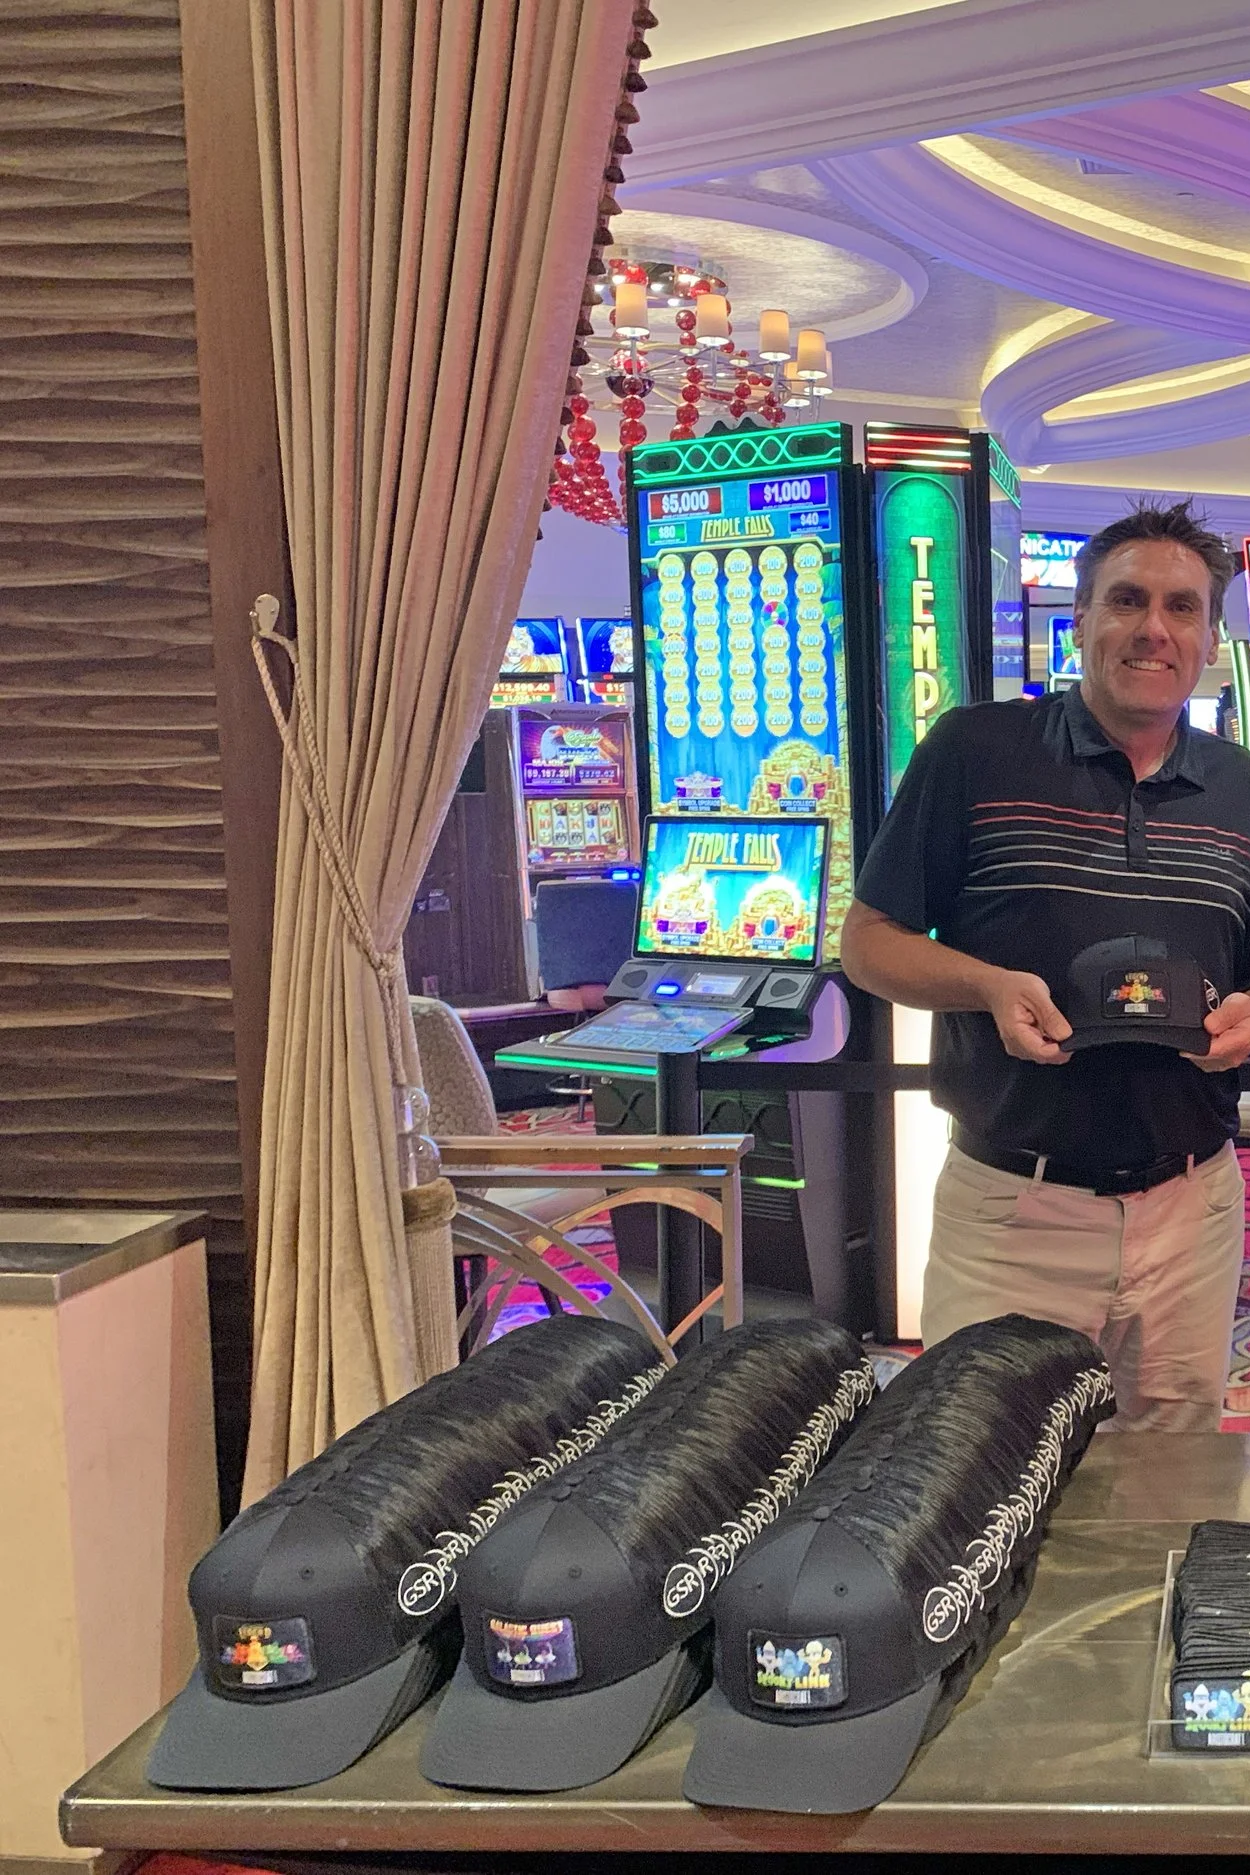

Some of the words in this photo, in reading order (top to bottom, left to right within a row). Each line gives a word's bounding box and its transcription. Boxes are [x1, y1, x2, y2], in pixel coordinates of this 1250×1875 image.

[662, 490, 709, 513] $5,000
[762, 480, 811, 503] $1,000
[701, 516, 740, 541] TEMPLE
[744, 514, 775, 538] FALLS
[800, 512, 819, 526] $40
[658, 526, 676, 538] $80
[684, 832, 739, 866] TEMPLE
[742, 832, 781, 867] FALLS
[403, 1570, 440, 1607] GSR
[666, 1570, 700, 1608] GSR
[926, 1595, 956, 1633] GSR
[795, 1673, 831, 1689] LINK
